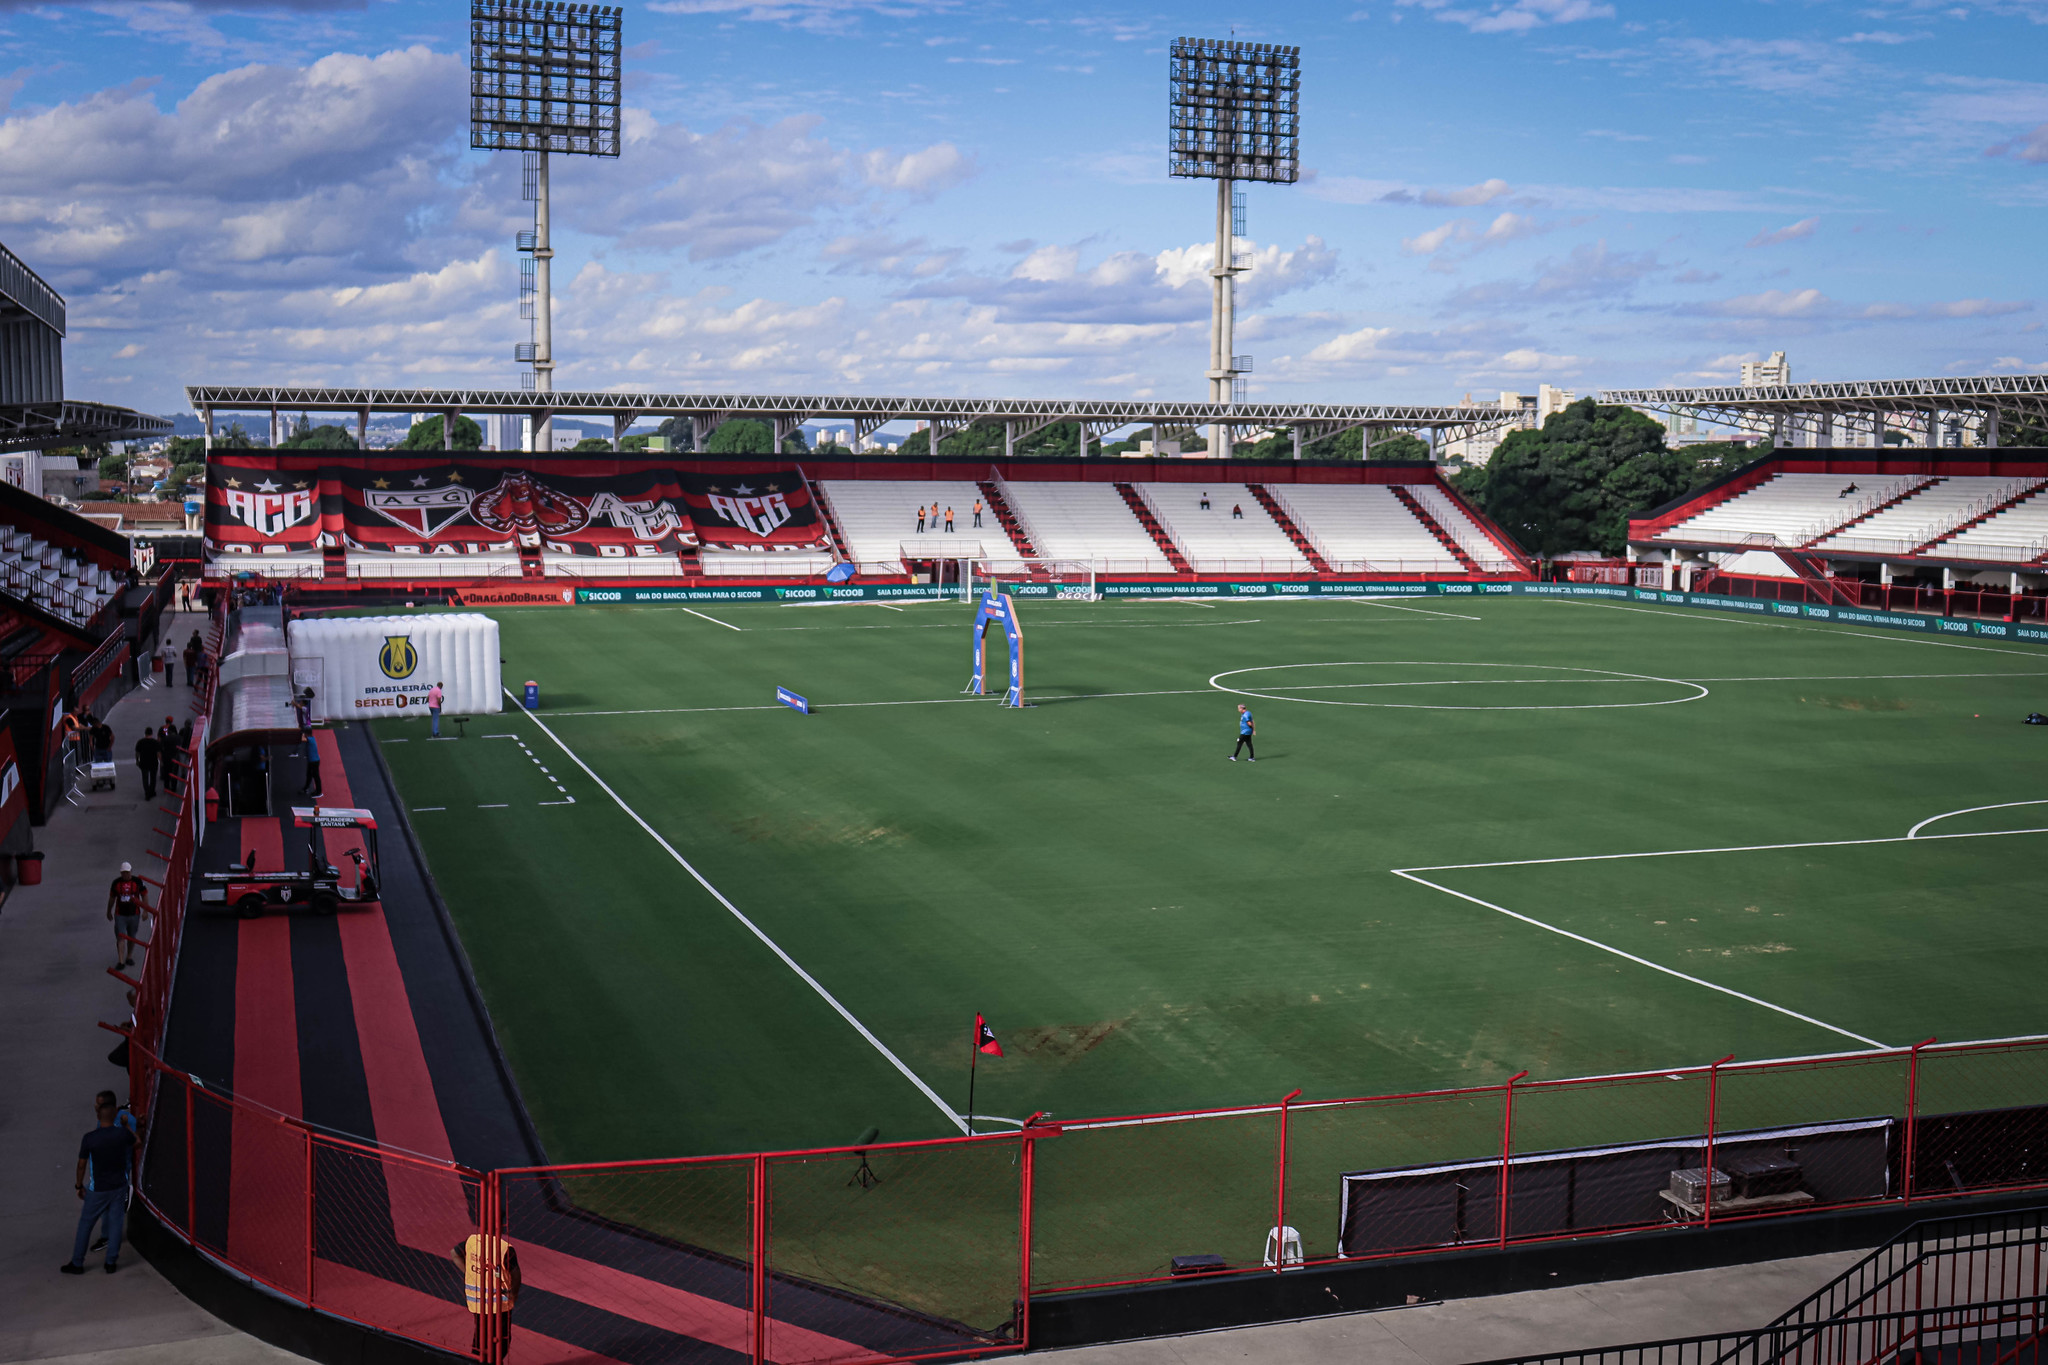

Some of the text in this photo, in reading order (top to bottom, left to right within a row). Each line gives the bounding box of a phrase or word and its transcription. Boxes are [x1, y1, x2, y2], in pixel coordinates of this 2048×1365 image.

[383, 490, 461, 505] ACG
[589, 592, 621, 600] SICOOB
[1778, 604, 1798, 614] SICOOB
[1809, 607, 1830, 618] SICOOB
[1874, 615, 1890, 624] VENHA
[1908, 619, 1926, 627] SICOOB
[1943, 621, 1968, 632] SICOOB
[1981, 625, 2006, 636] SICOOB
[365, 683, 433, 694] BRASILEIRÃO
[355, 698, 394, 708] SÉRIE
